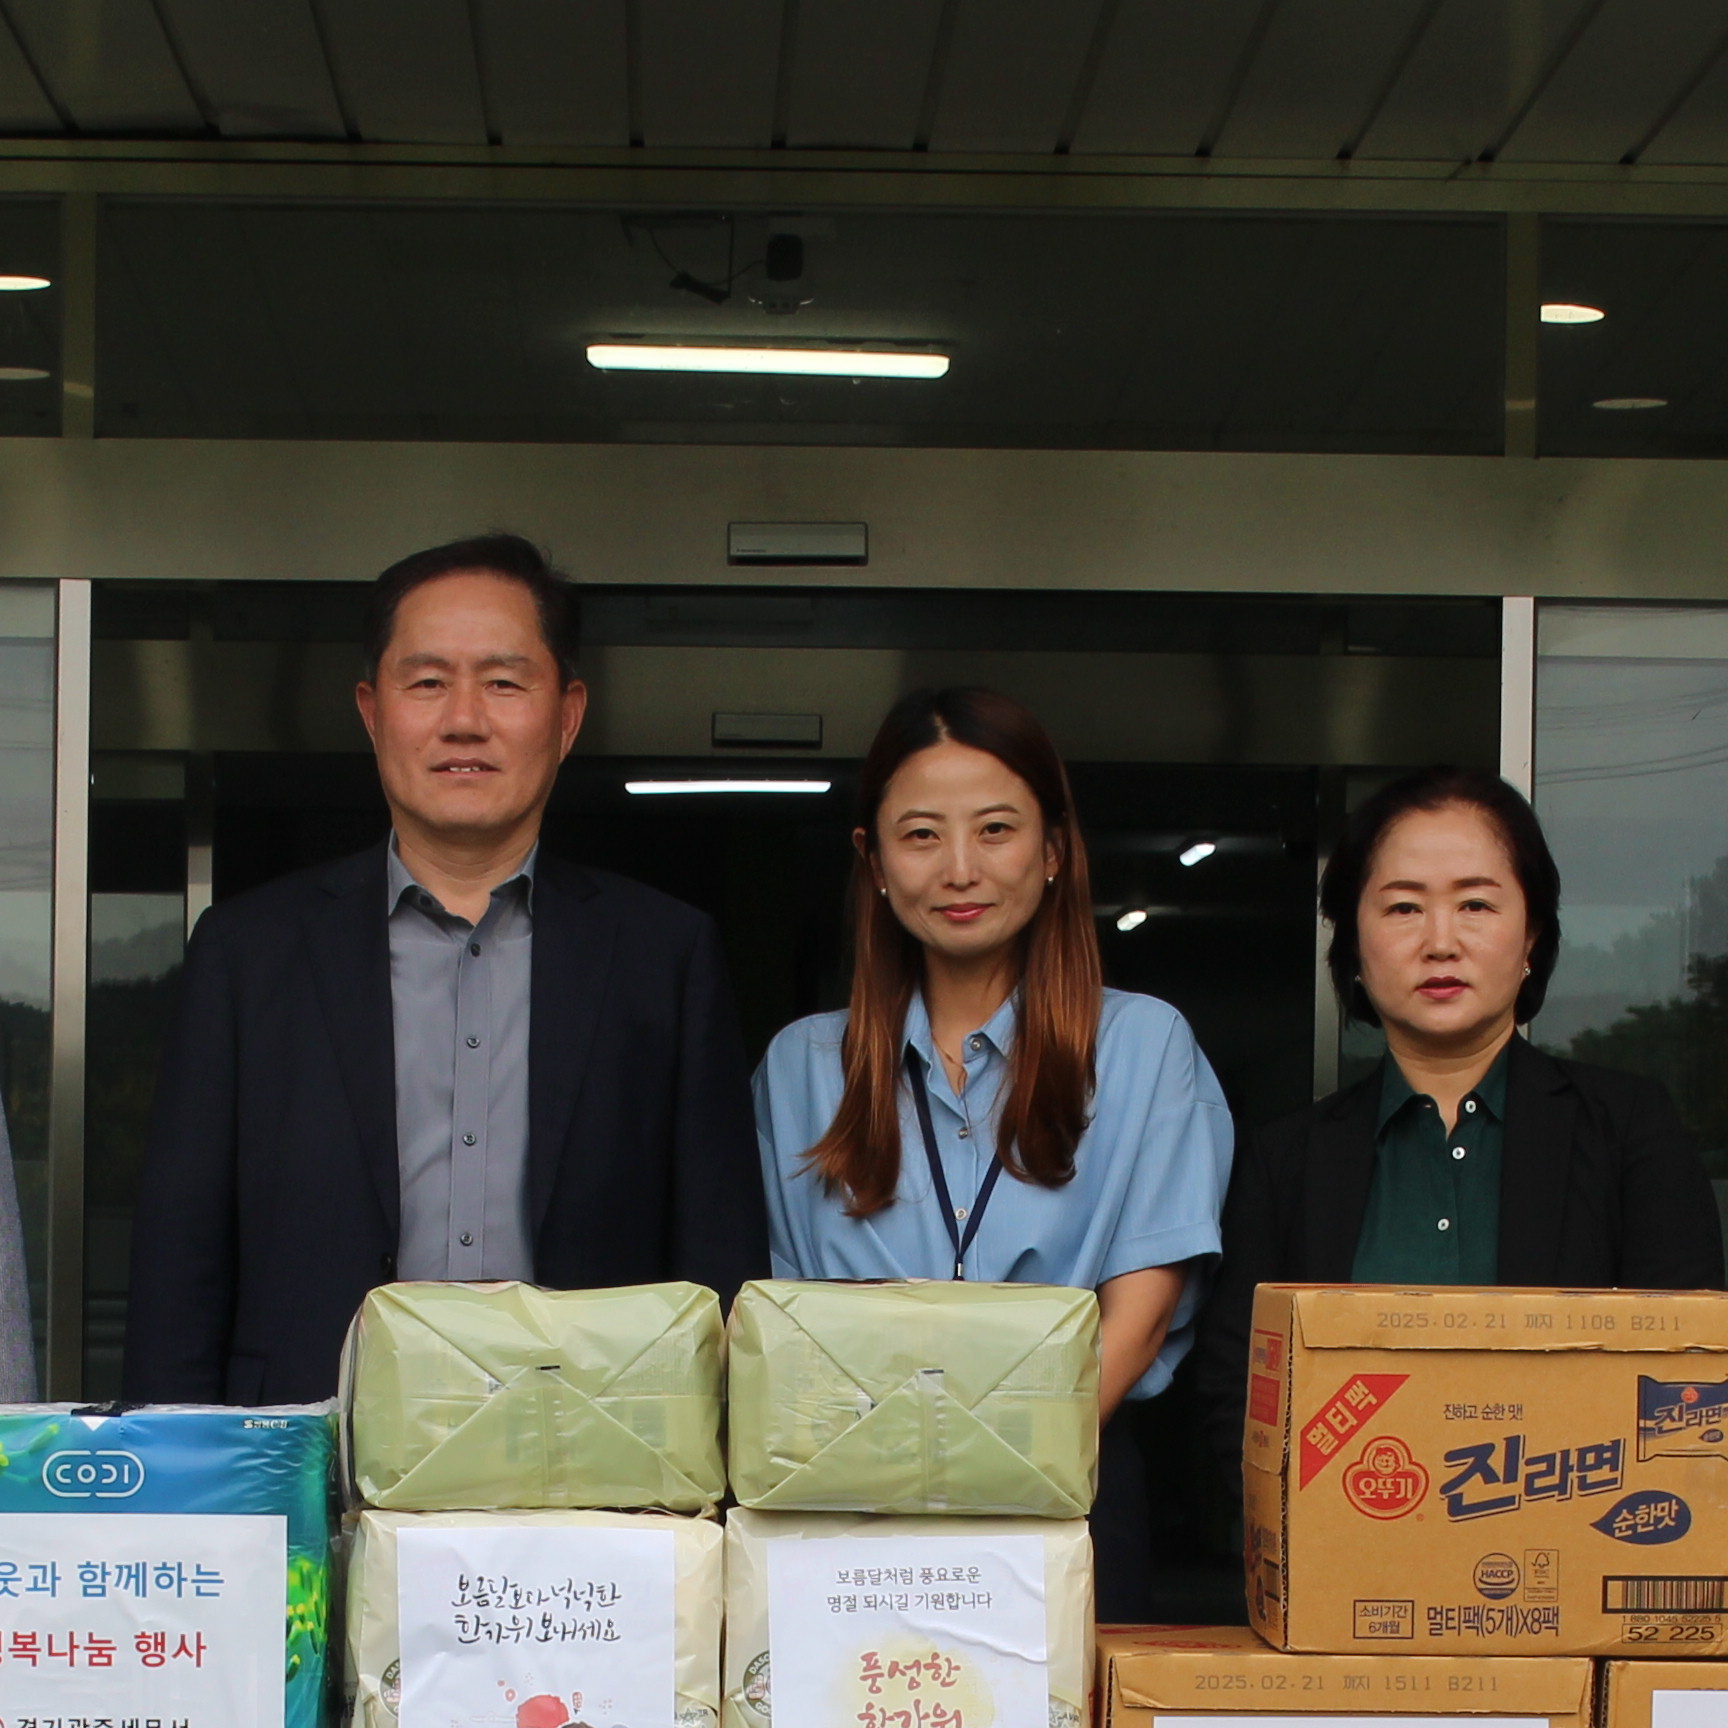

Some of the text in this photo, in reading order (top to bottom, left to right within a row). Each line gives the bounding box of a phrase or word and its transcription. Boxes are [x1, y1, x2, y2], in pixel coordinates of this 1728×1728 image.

[1377, 1312, 1682, 1332] 2025.02.21 까지 1108 B211
[1306, 1380, 1377, 1456] 멀티팩
[1443, 1403, 1523, 1420] 진하고 순한 맛!
[1654, 1401, 1723, 1435] 진라면
[55, 1462, 129, 1484] CODI
[1439, 1434, 1627, 1522] 진라면
[1358, 1476, 1414, 1500] 오뚜기
[1613, 1499, 1679, 1538] 순한맛
[76, 1560, 226, 1599] 함께하는
[836, 1566, 981, 1588] 보름달처럼 풍요로운
[1480, 1569, 1514, 1580] HACCP
[450, 1572, 624, 1612] 보름달보다 넉넉한
[827, 1592, 992, 1613] 명절 되시길 기원합니다
[1359, 1605, 1408, 1619] 소비기간
[1427, 1604, 1560, 1638] 멀티팩(5개)X8팩
[453, 1611, 623, 1646] 한가위 보내세요
[1368, 1620, 1401, 1634] 6개월
[1627, 1626, 1716, 1642] 52 225
[134, 1630, 208, 1669] 행사
[858, 1650, 961, 1695] 풍성한
